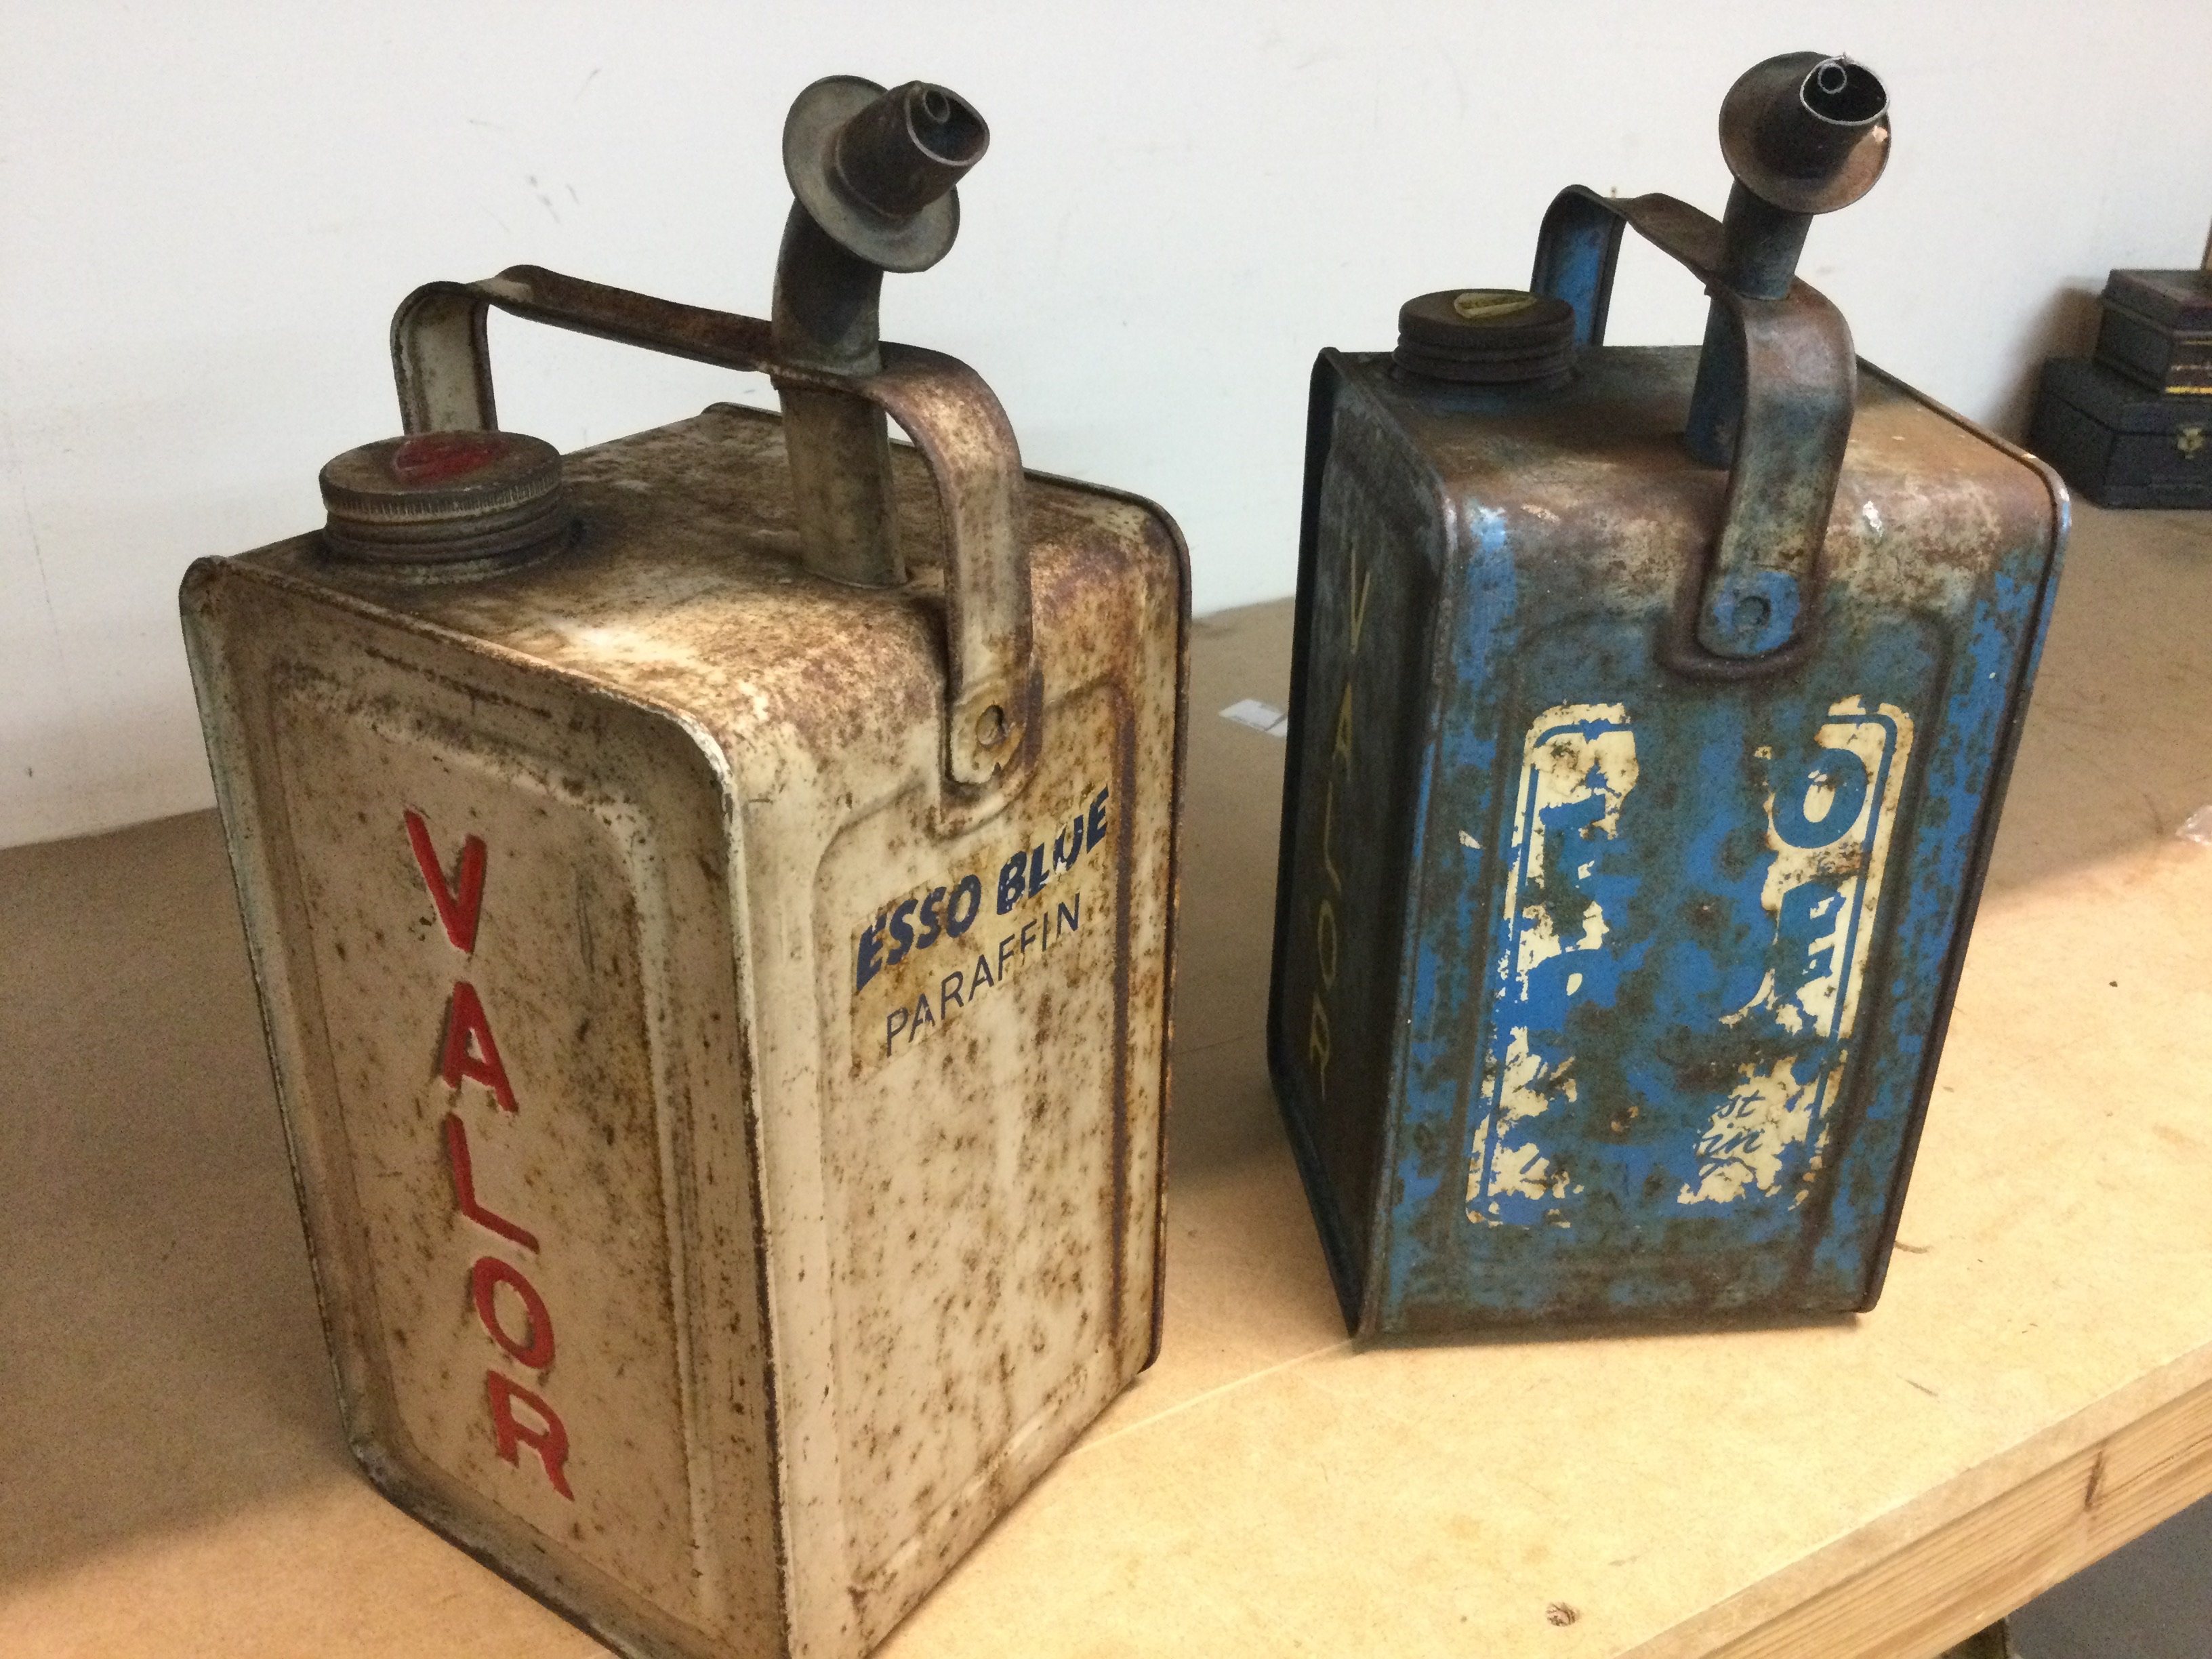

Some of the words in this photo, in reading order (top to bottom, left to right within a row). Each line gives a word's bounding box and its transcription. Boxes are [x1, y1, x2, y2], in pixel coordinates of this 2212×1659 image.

[855, 874, 982, 991] ESSO
[996, 785, 1109, 915] BLUE
[885, 893, 1080, 1057] PARAFFIN
[1309, 540, 1371, 1102] VALOR
[406, 806, 575, 1500] VALOR
